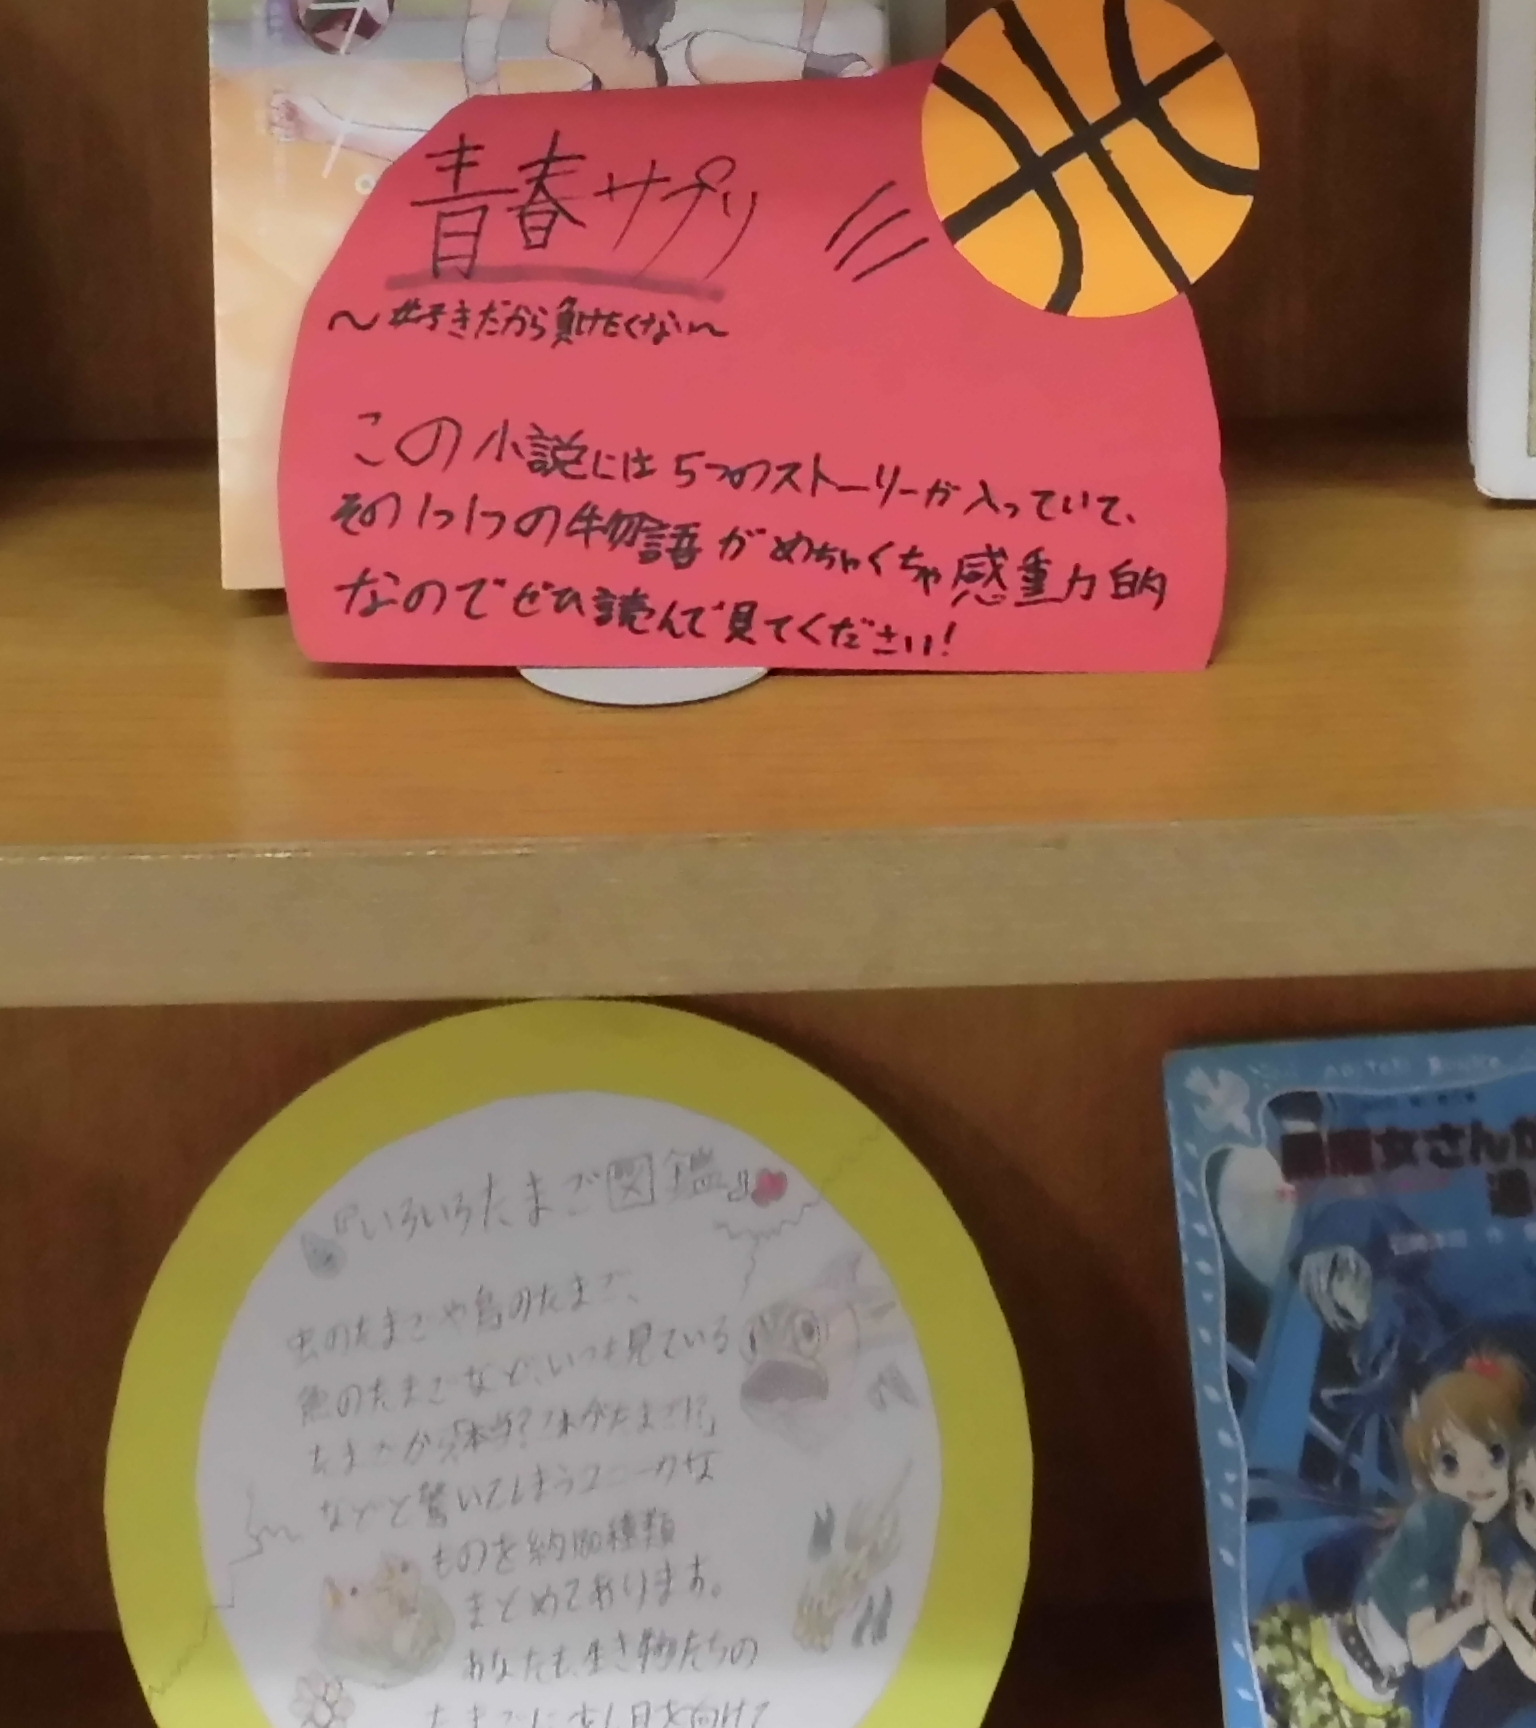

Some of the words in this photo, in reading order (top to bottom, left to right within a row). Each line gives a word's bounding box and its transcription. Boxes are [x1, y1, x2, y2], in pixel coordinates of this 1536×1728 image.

[409, 128, 760, 282] 青春サプリ
